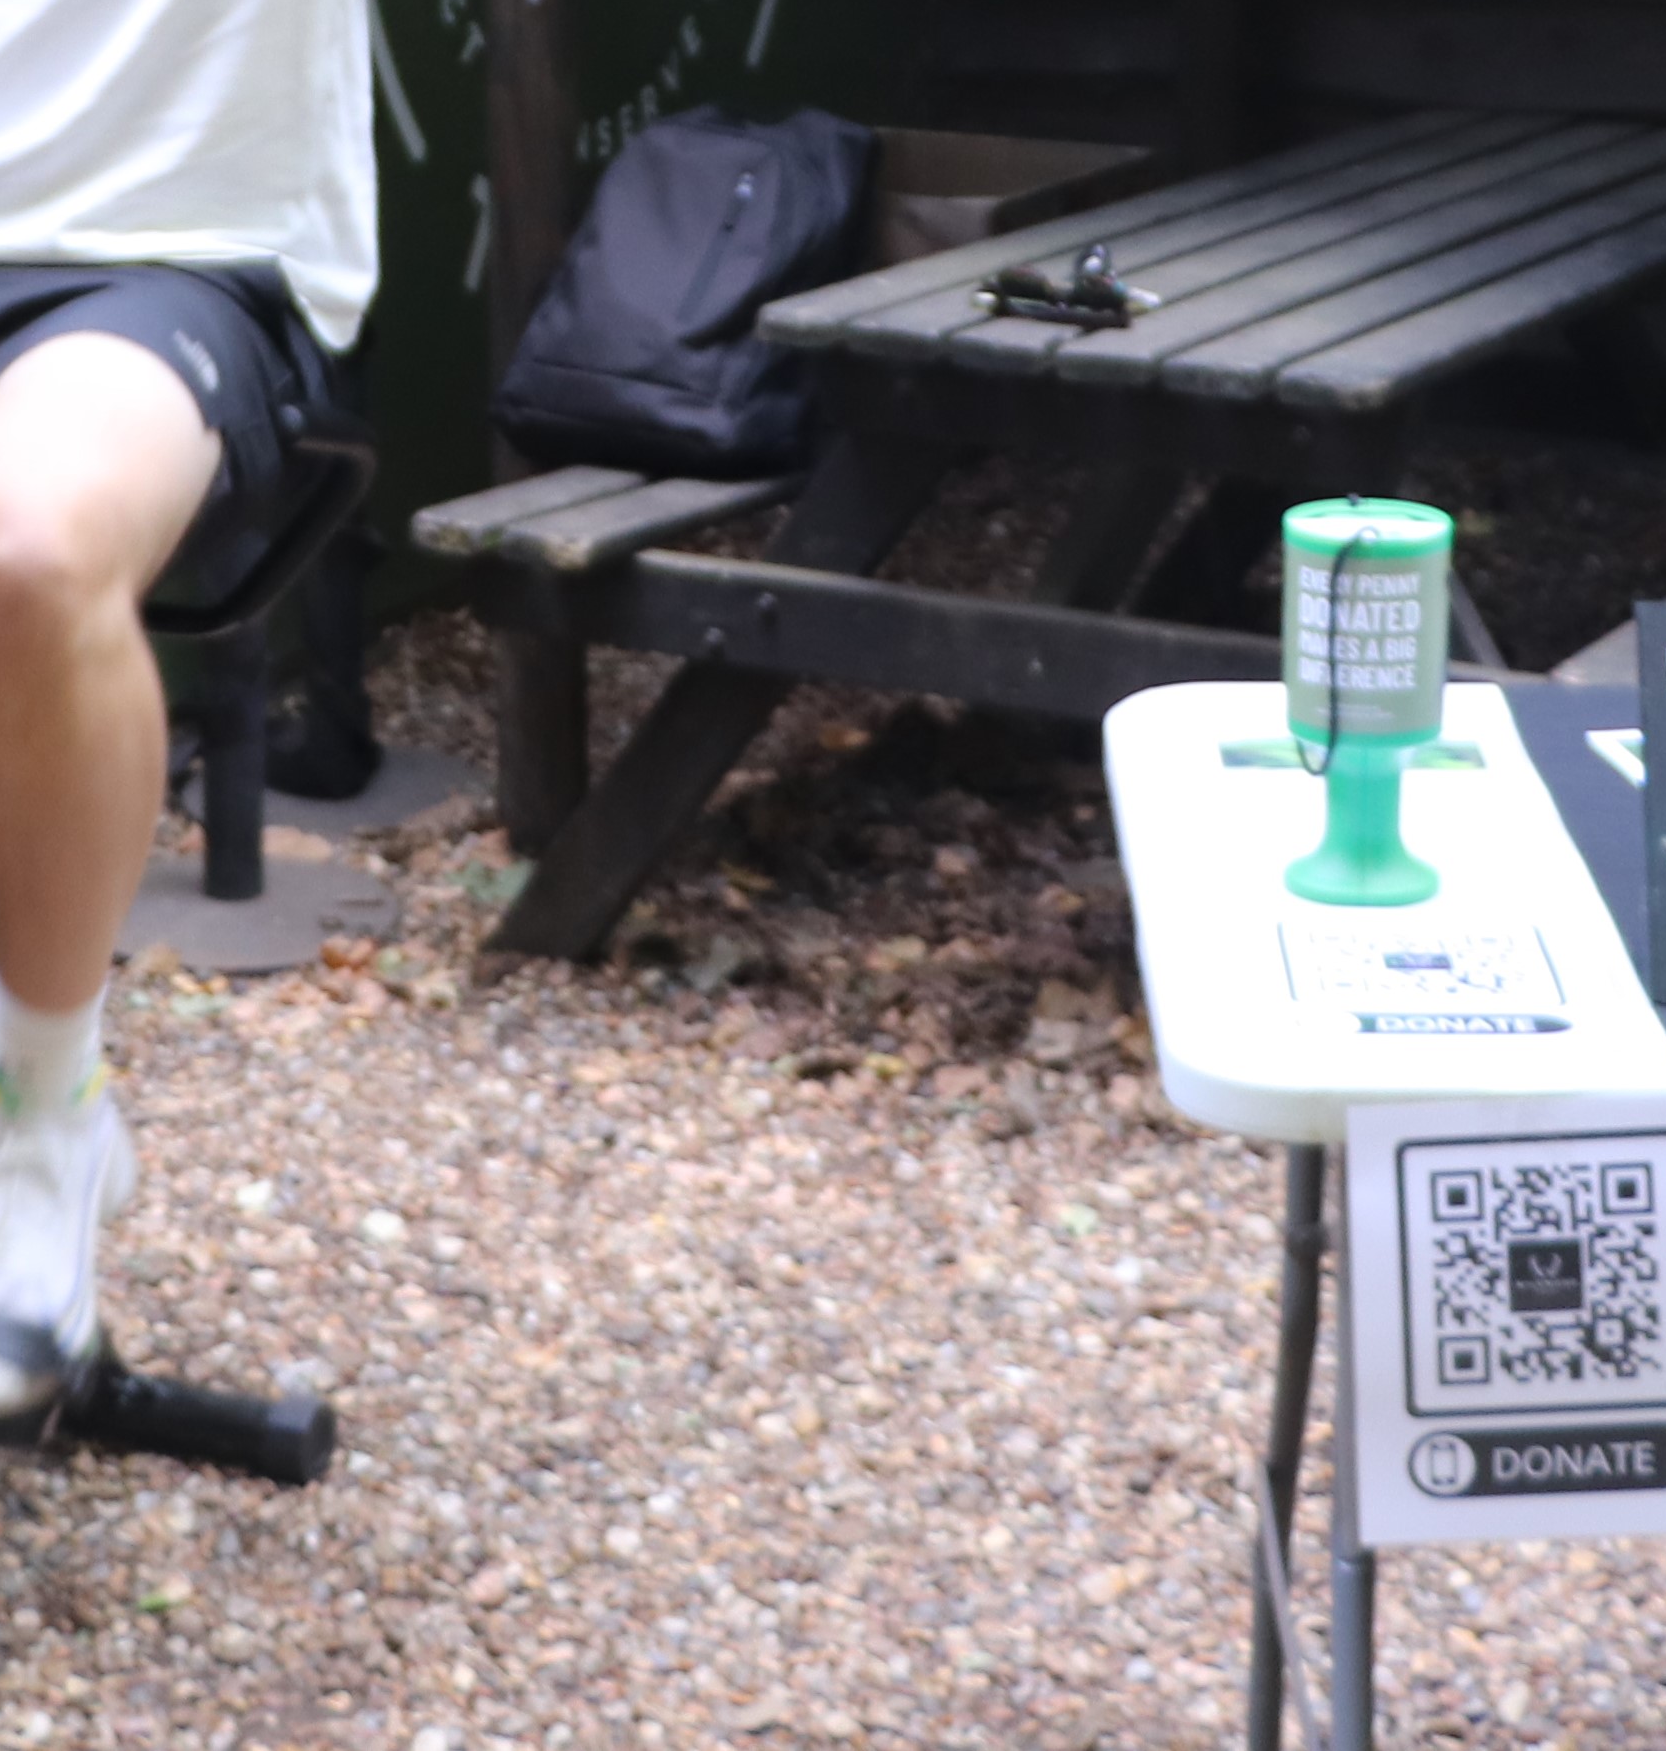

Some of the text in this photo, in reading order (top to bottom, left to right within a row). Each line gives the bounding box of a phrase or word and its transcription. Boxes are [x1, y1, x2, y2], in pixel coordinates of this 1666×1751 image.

[1357, 572, 1421, 596] PENNY
[1299, 592, 1421, 632] DONATED
[1299, 629, 1417, 661] MAES A BIG
[1374, 1014, 1534, 1033] DONATE
[1490, 1440, 1657, 1482] DONATE
